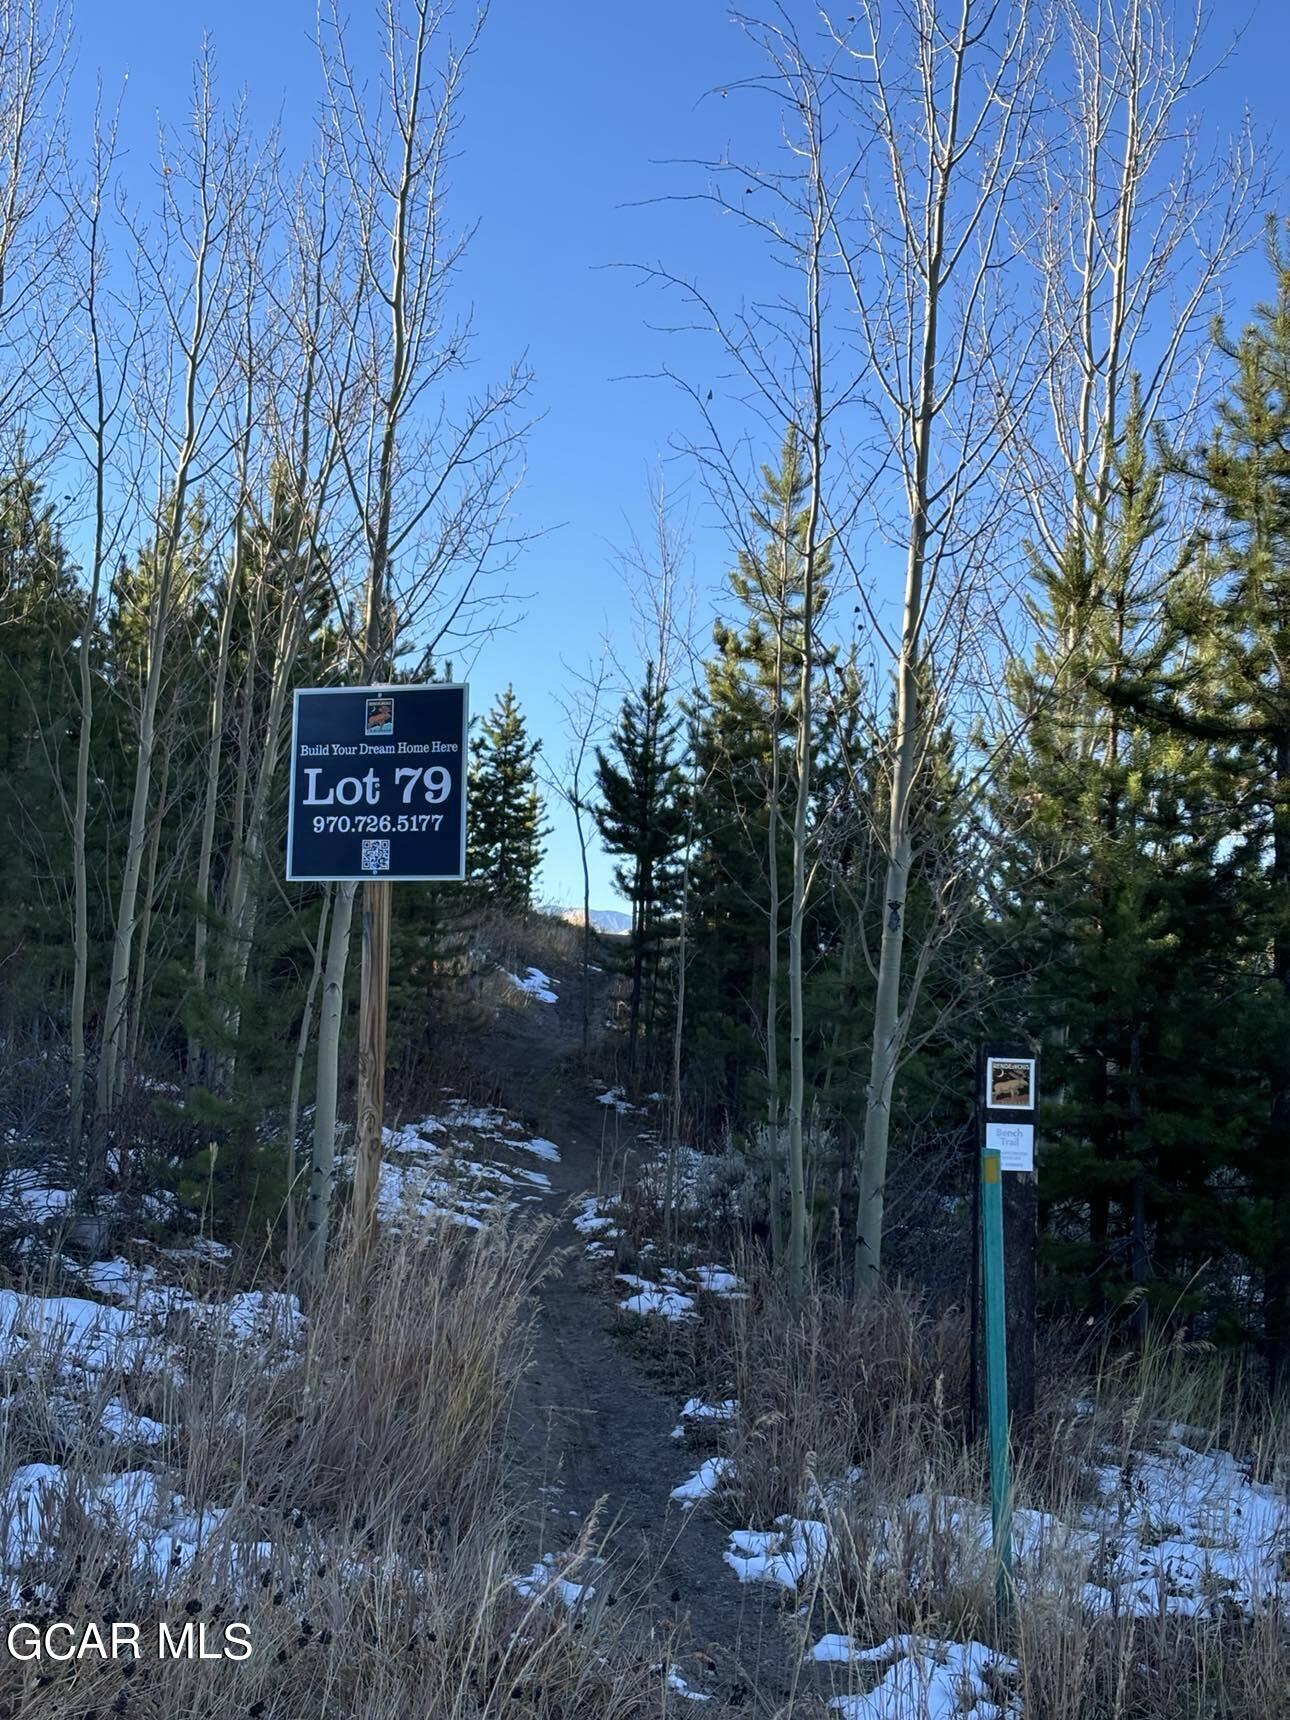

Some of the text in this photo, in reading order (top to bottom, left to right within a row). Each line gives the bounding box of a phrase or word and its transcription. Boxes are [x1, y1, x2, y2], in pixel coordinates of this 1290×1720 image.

[300, 741, 458, 756] Build Your Dream Home Here
[303, 766, 452, 805] Lot 79
[312, 815, 443, 833] 970.726.5177
[996, 1128, 1023, 1137] Bench
[1000, 1137, 1020, 1146] Trail
